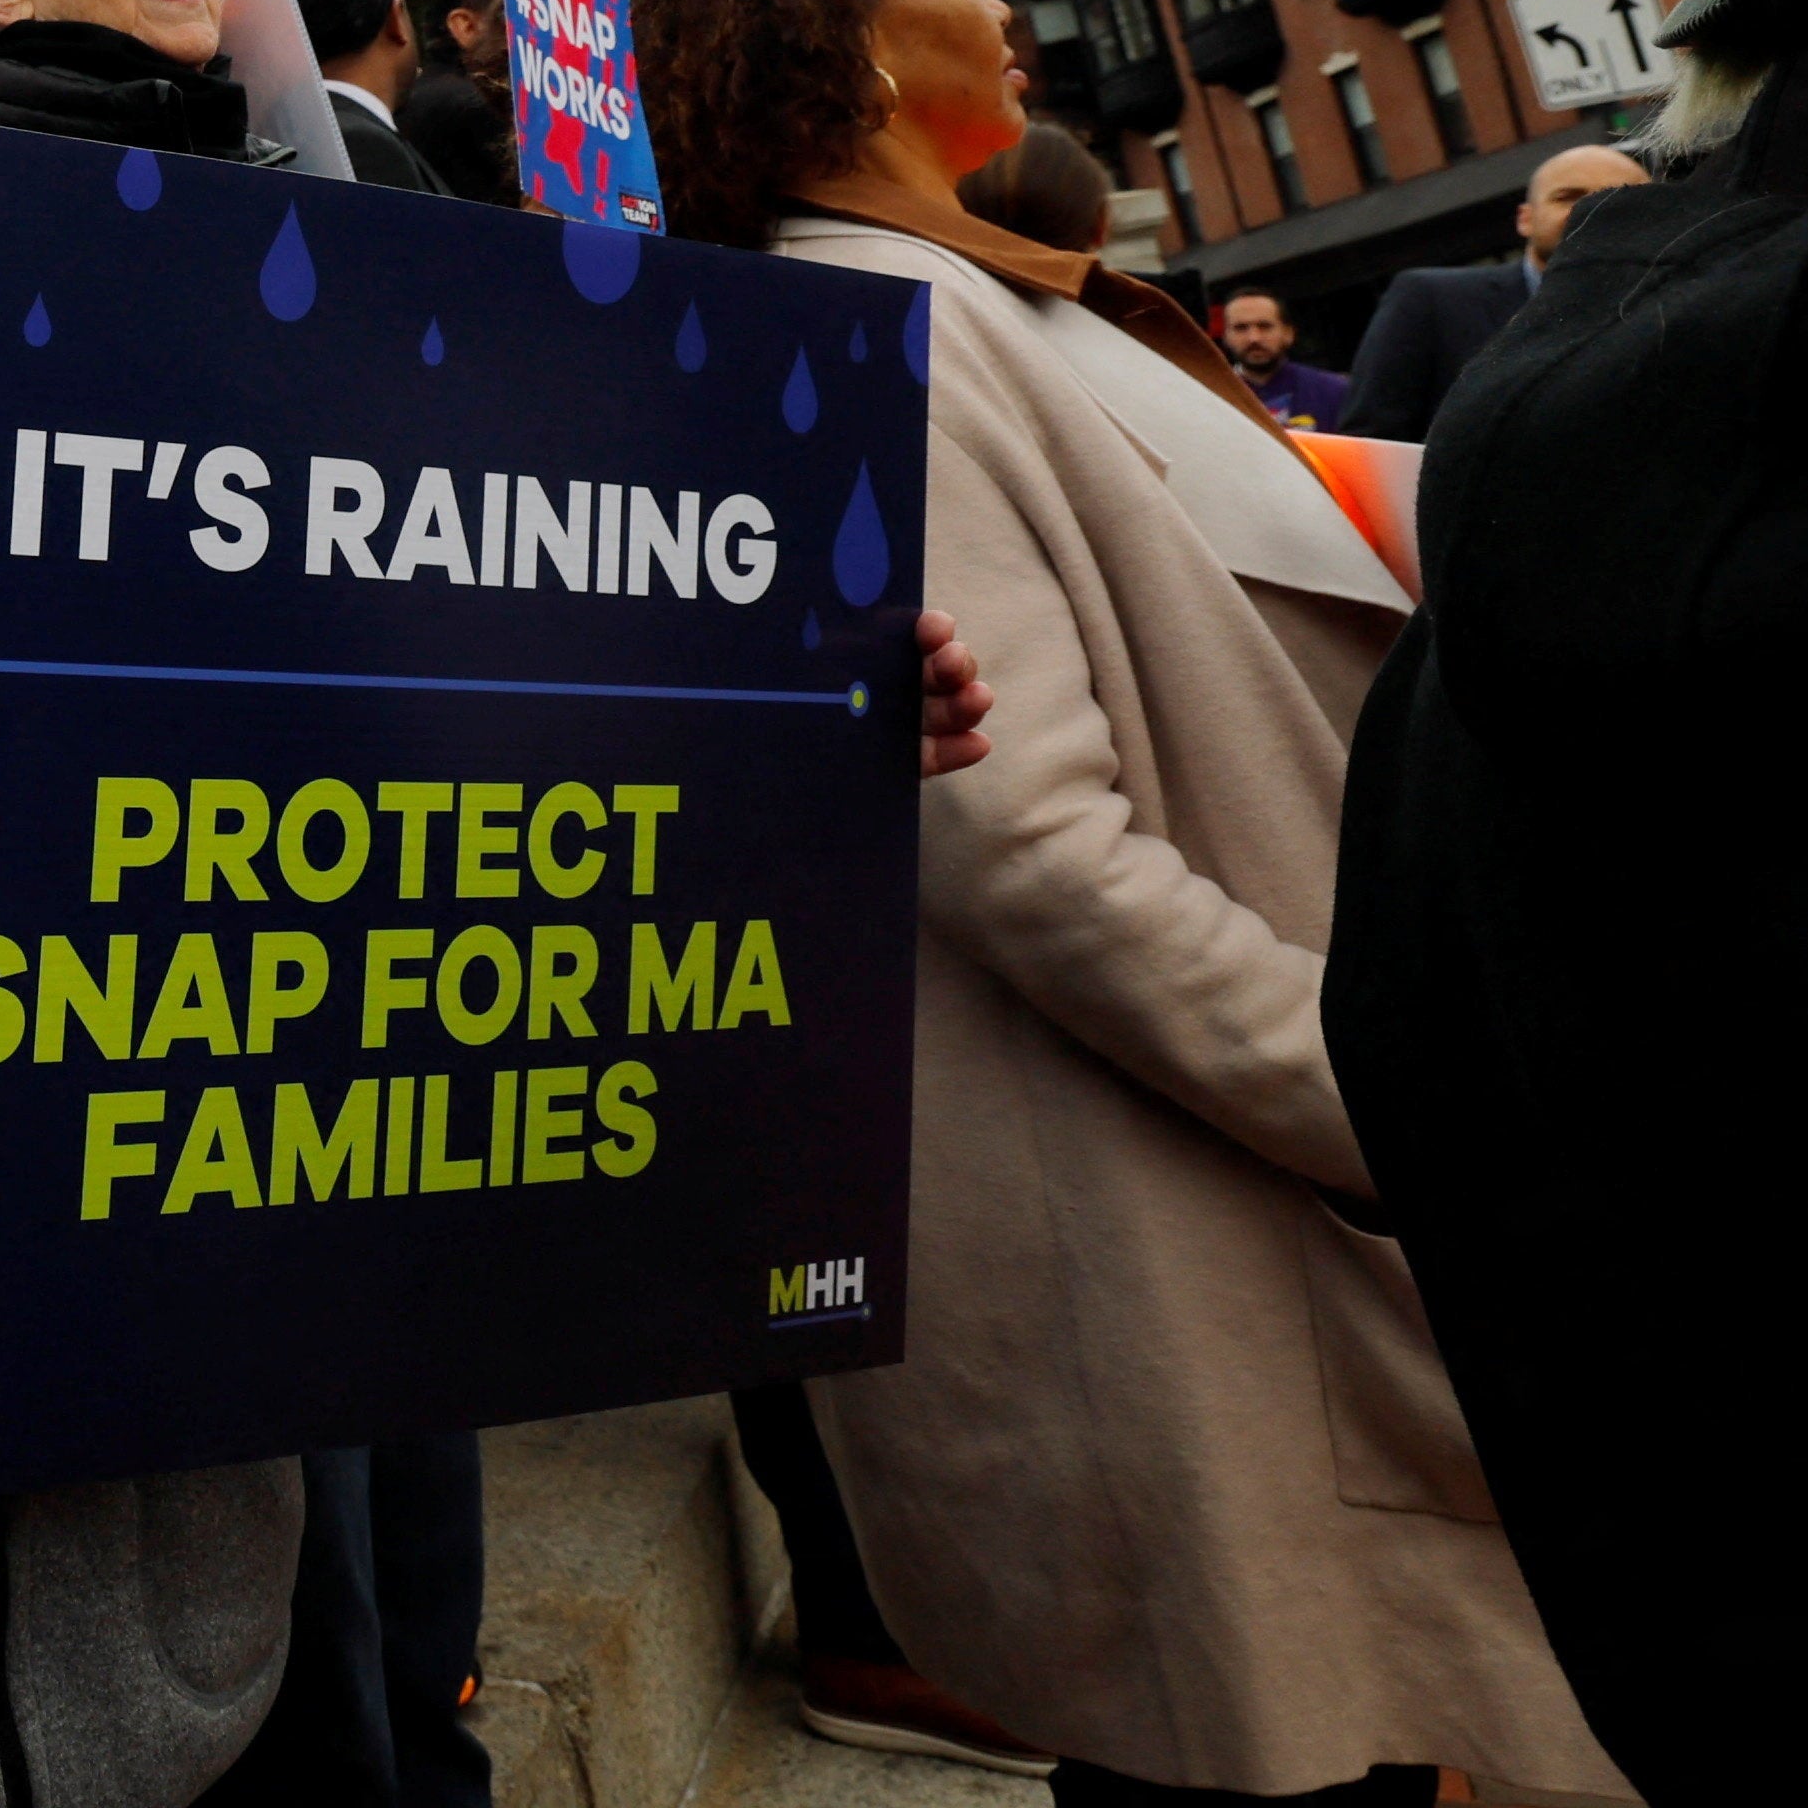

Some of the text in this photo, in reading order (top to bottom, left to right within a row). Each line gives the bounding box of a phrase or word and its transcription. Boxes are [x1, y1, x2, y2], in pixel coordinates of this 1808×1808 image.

[517, 35, 632, 141] WORKS
[10, 429, 776, 604] IT'S RAINING
[91, 777, 679, 902] PROTECT
[363, 925, 598, 1048] FOR
[629, 920, 790, 1033] MA
[81, 1061, 657, 1220] FAMILIES
[770, 1257, 864, 1314] MHH
